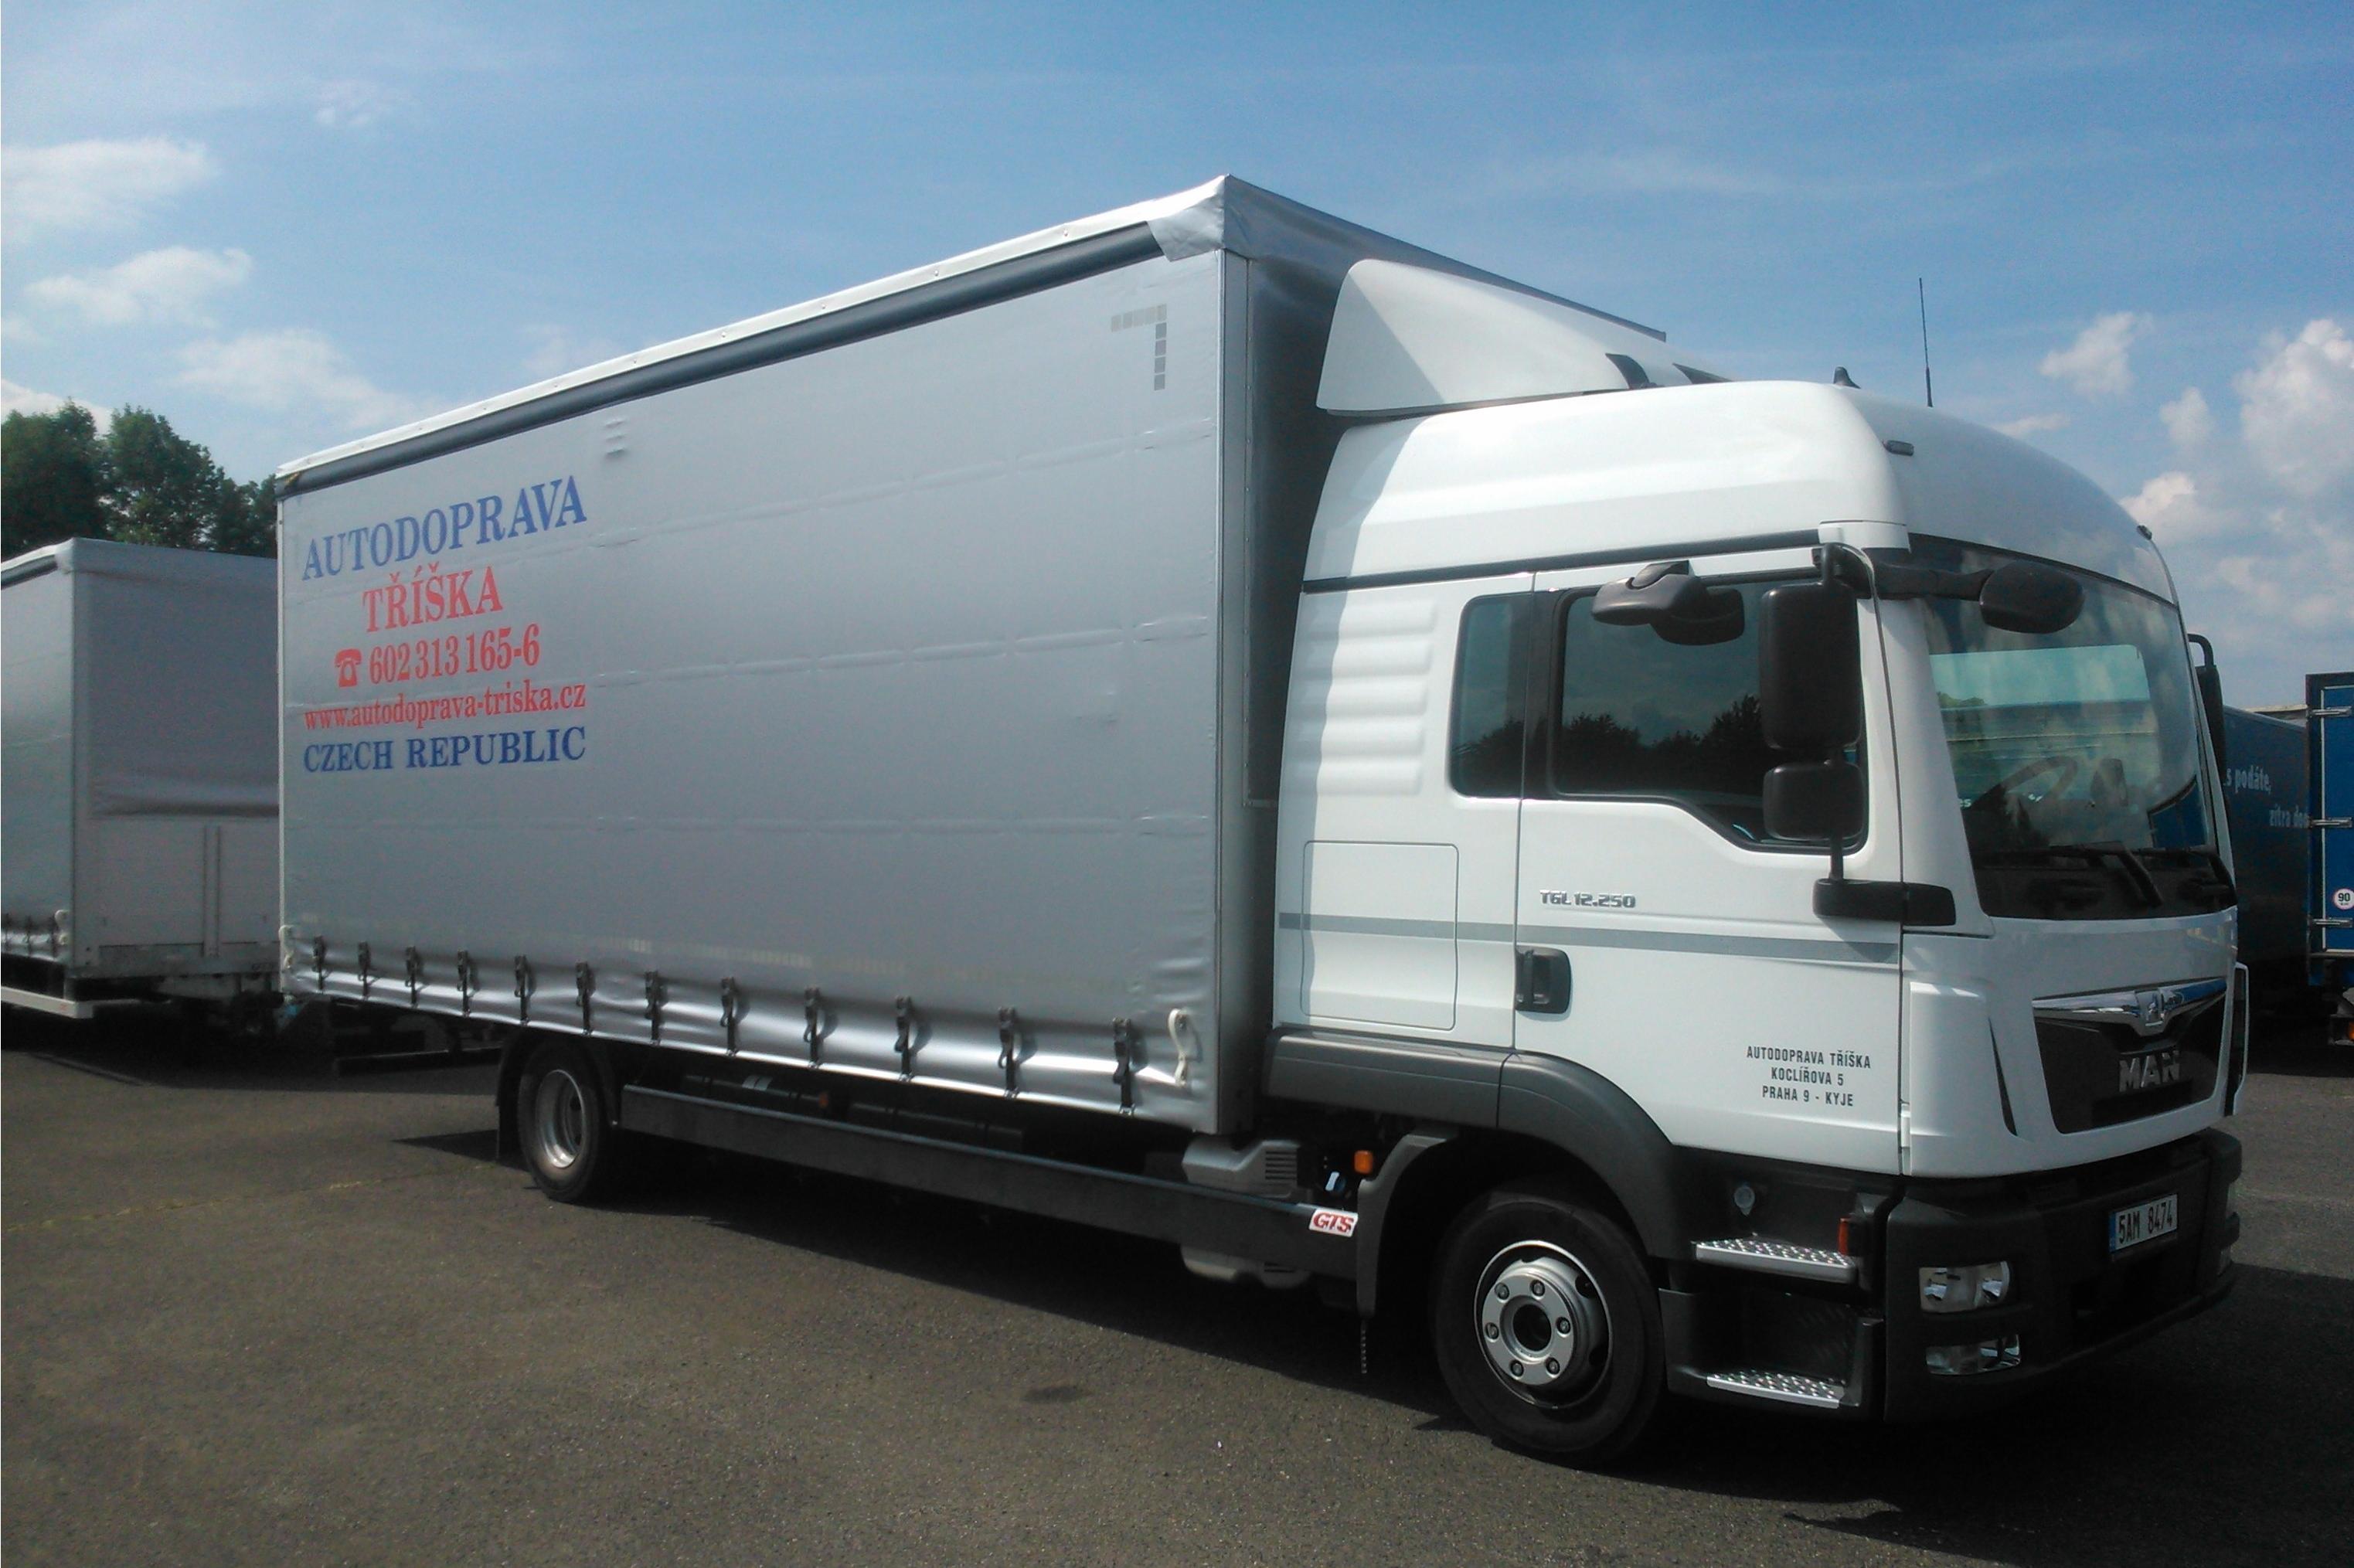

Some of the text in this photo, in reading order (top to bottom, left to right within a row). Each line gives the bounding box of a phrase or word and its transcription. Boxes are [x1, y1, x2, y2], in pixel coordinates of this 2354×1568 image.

[301, 475, 587, 581] AUTODOPRAVA
[362, 561, 503, 632] TŘÍŠKA
[369, 623, 539, 685] 602 313 165-6
[304, 679, 586, 730] www.autodoprava-triska.cz
[304, 726, 586, 773] CZECH REPUBLIC
[1539, 889, 1636, 908] TGL 12.250
[2338, 893, 2350, 902] 90
[1747, 1046, 1871, 1069] AUTODOPRAVA TŘÍŠKA
[2119, 1049, 2180, 1092] MAN
[1771, 1066, 1844, 1086] KOCLÍŘOVA 5
[1762, 1086, 1798, 1100] PRAHA
[1804, 1090, 1809, 1102] 9
[1825, 1092, 1853, 1107] KYJE
[1313, 1212, 1354, 1233] GTS
[2118, 1211, 2140, 1244] 5AM
